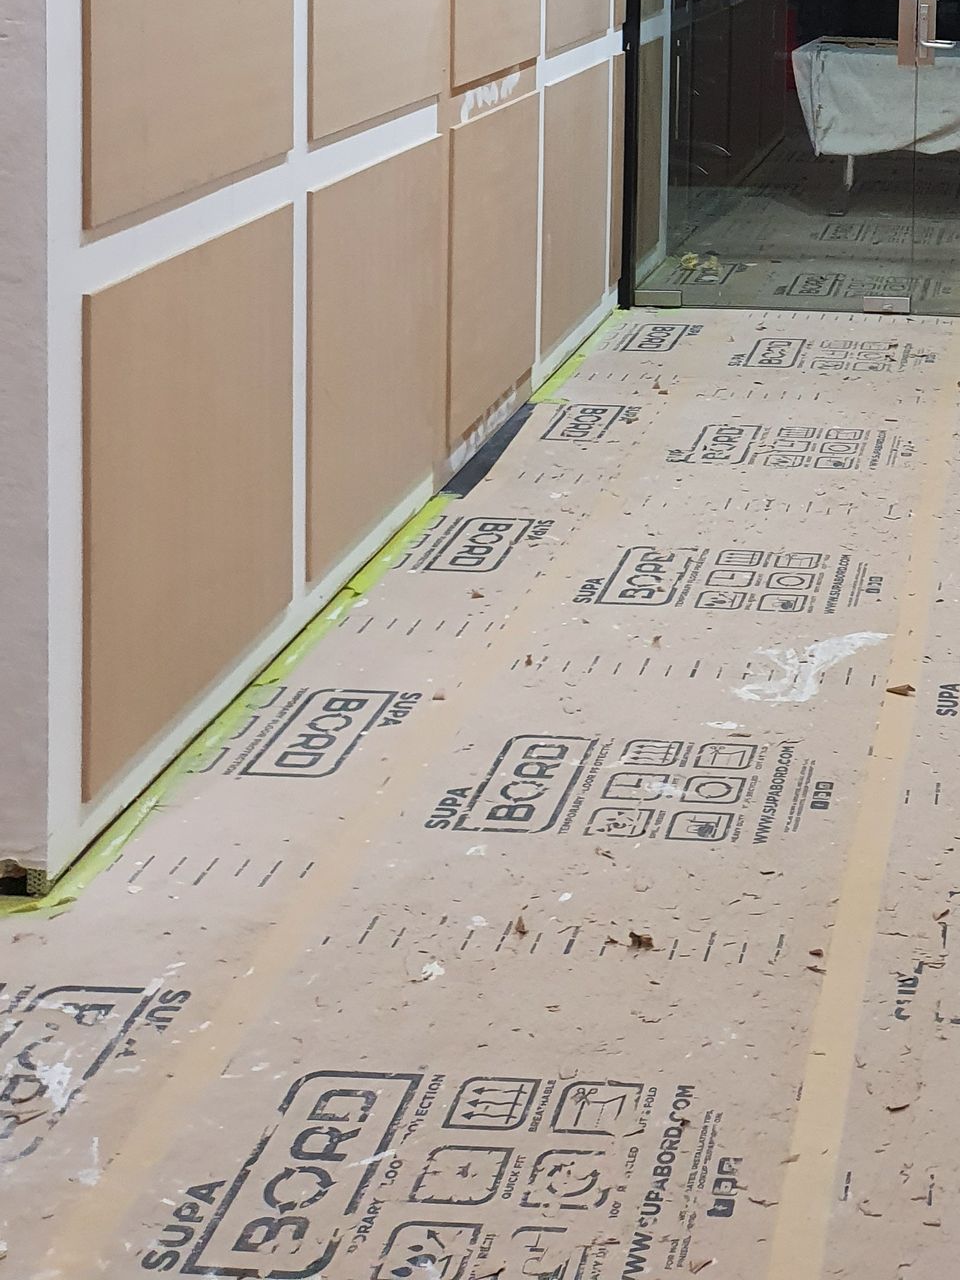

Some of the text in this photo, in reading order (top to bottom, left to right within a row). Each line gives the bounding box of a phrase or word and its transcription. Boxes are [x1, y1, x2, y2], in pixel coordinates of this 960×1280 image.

[449, 522, 513, 567] BORD
[376, 692, 423, 729] SUPA
[936, 683, 960, 718] SUPA
[274, 696, 369, 768] BORD
[486, 743, 569, 822] BORD
[582, 774, 596, 794] LOOR
[424, 787, 474, 830] SUPA
[642, 1086, 658, 1110] FOLD
[501, 1154, 527, 1201] QUICK FIT
[141, 1179, 228, 1272] SUPA
